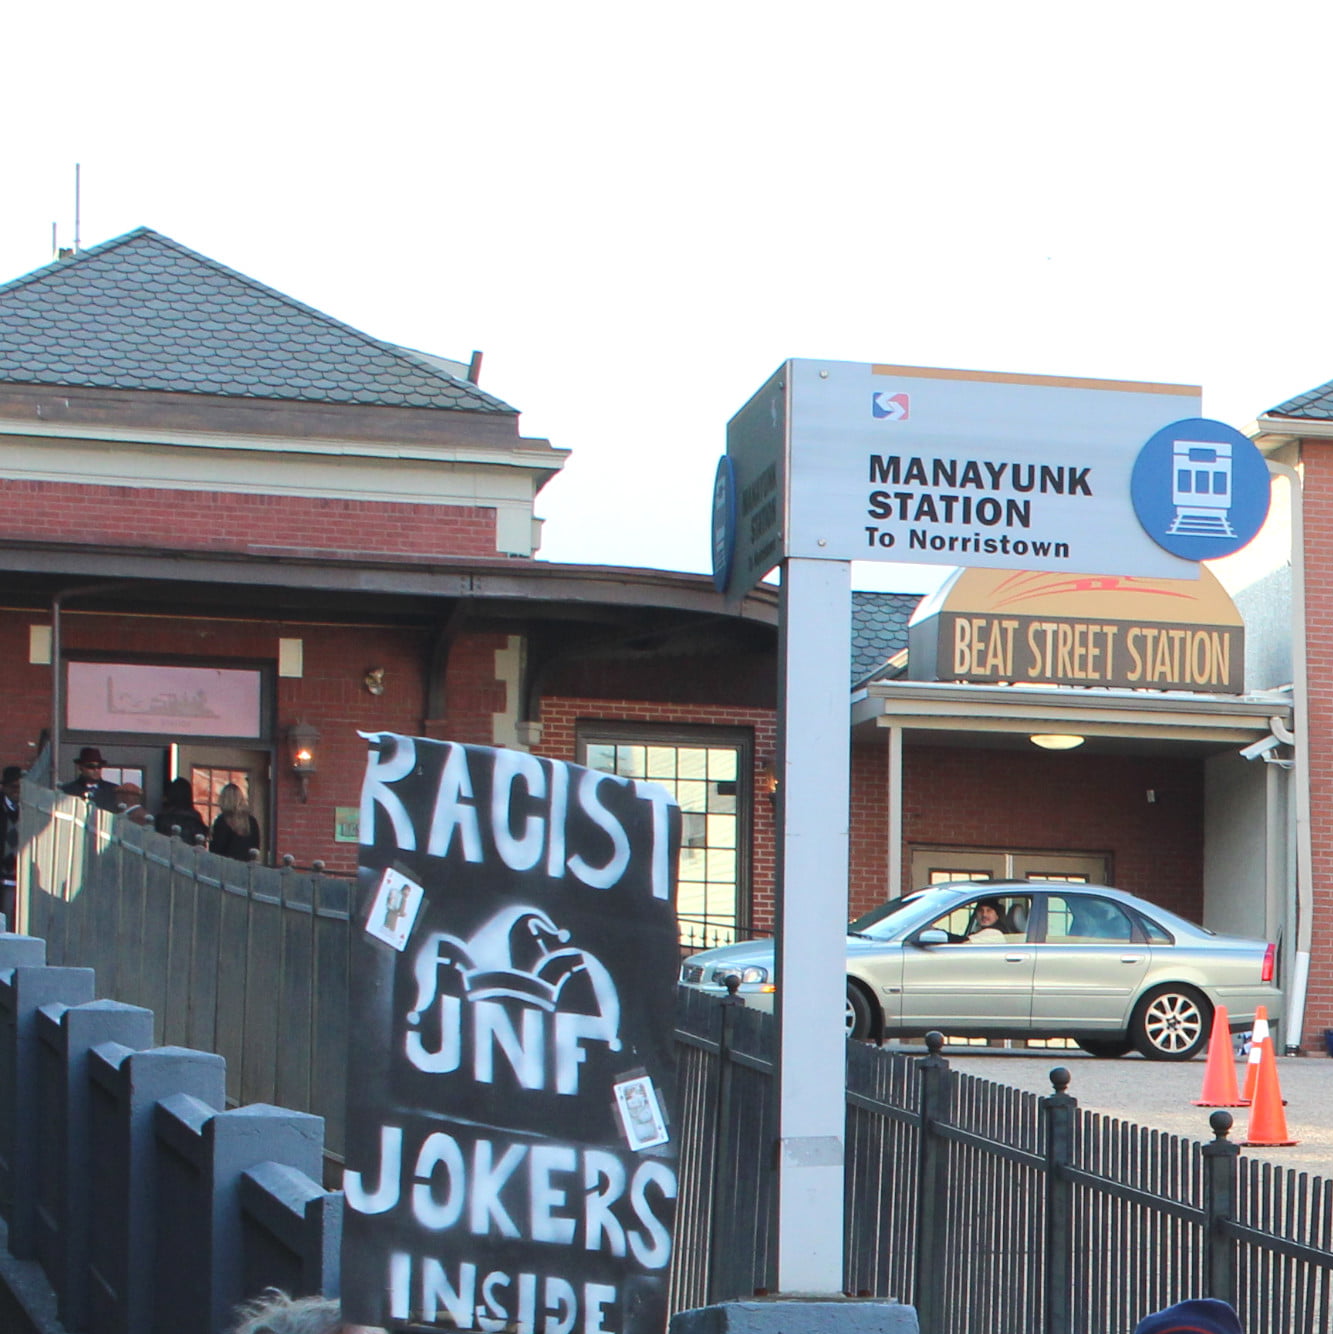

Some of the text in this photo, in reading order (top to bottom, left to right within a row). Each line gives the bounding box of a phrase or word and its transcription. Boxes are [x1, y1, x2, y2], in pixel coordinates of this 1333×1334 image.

[867, 491, 1031, 528] STATION
[869, 454, 1093, 496] MANAYUNK
[865, 527, 1069, 558] To Norristown
[953, 617, 1231, 686] BEAT STREET STATION
[359, 732, 681, 900] RACIST
[404, 996, 595, 1095] JNF
[343, 1125, 678, 1270] JOKERS
